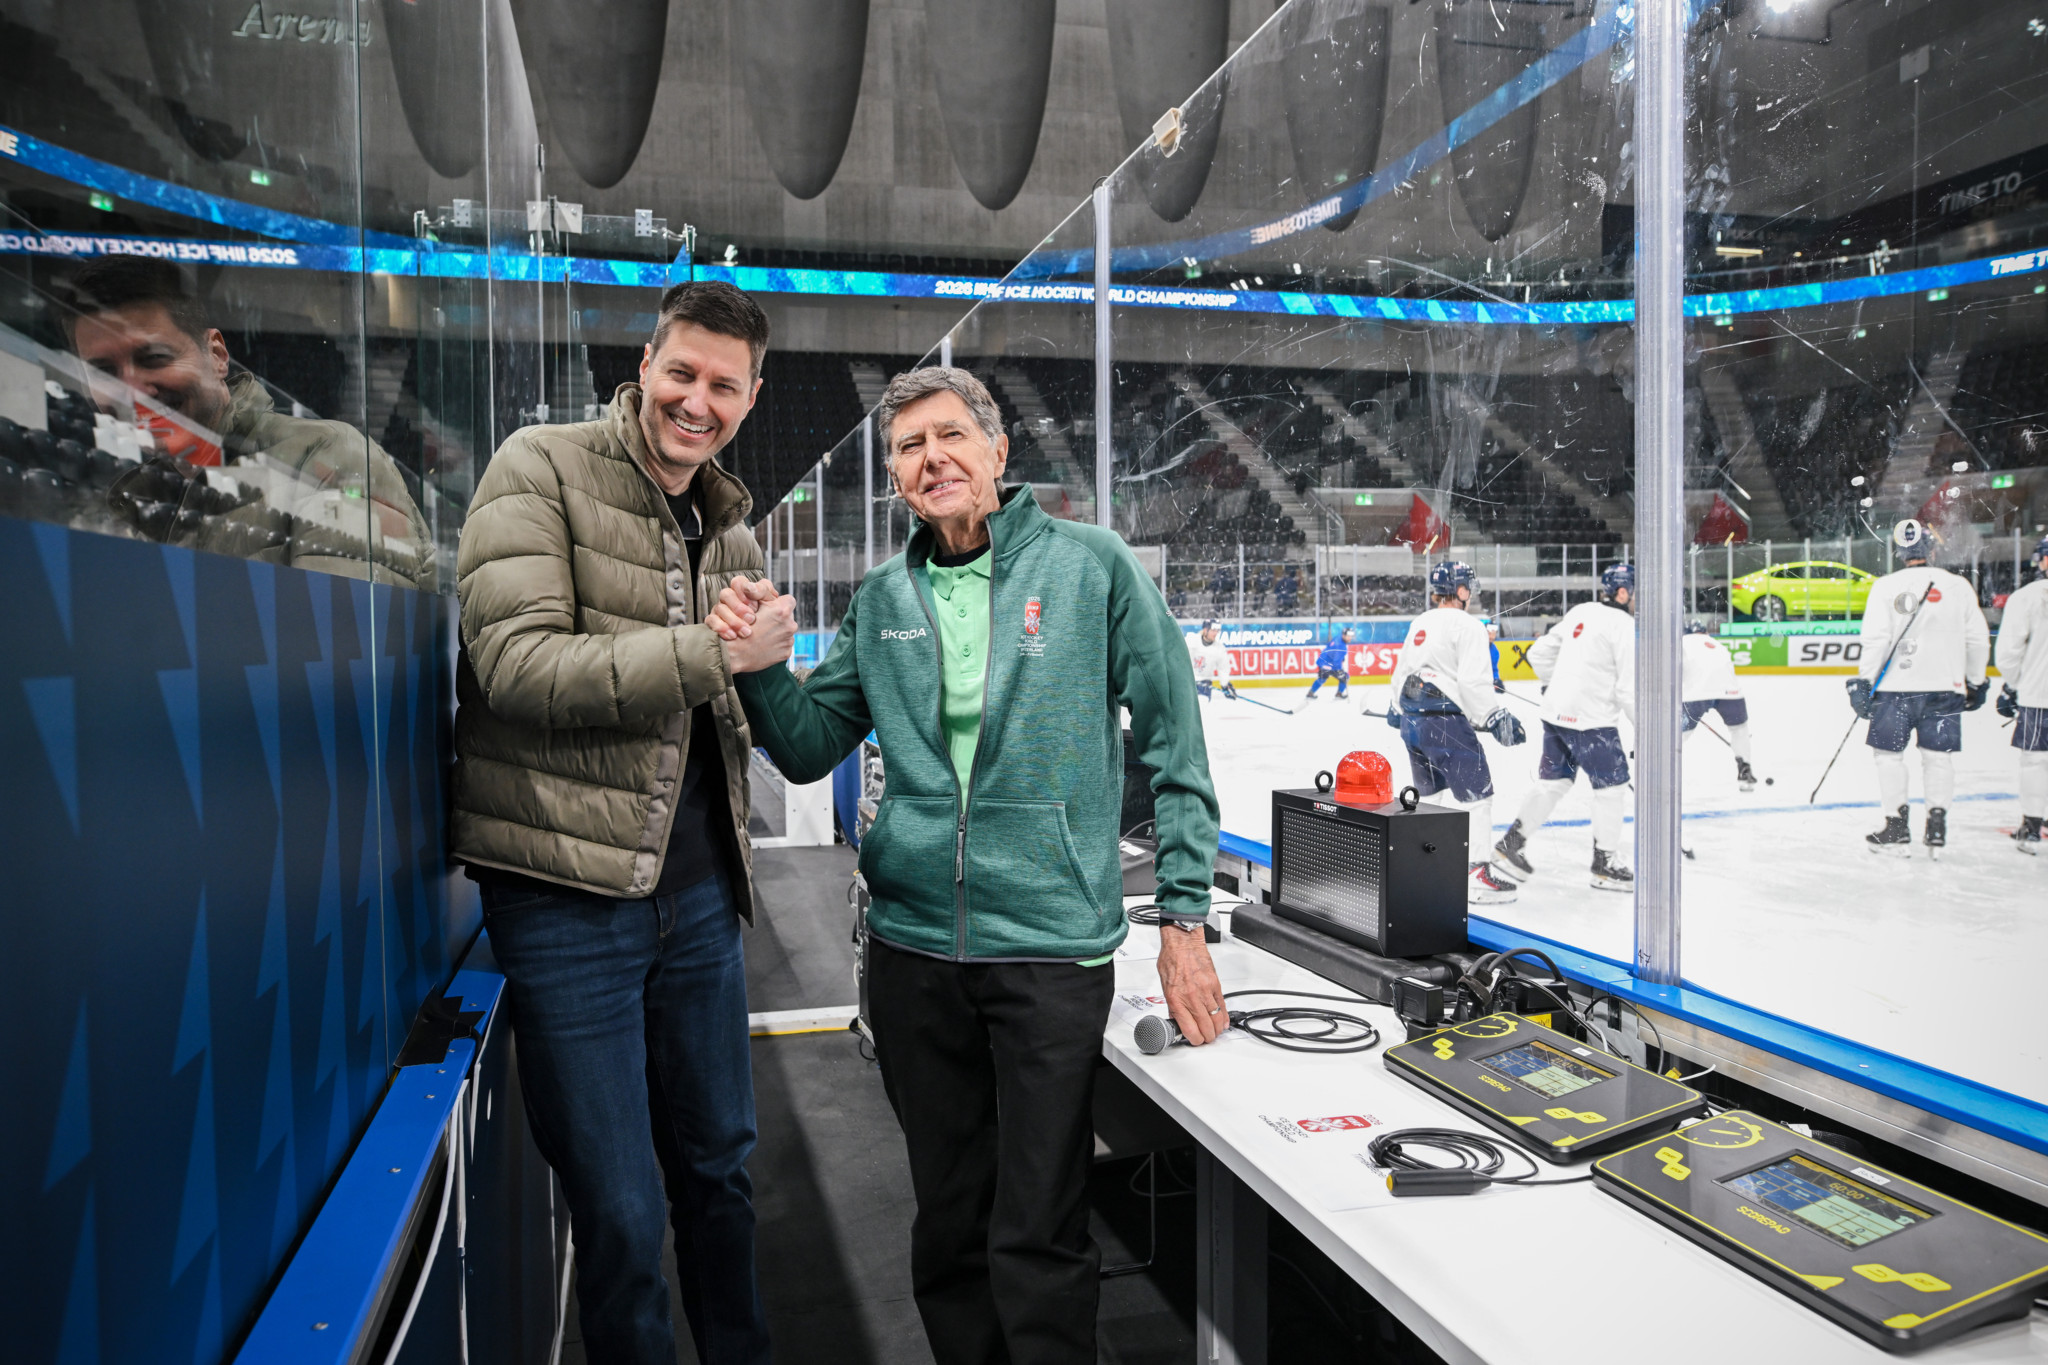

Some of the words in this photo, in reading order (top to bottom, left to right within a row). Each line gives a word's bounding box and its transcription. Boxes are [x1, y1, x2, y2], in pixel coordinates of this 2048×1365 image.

[1992, 172, 2022, 197] TO
[1990, 253, 2036, 275] TIME
[2036, 250, 2048, 267] T
[1004, 286, 1031, 299] ICE
[1030, 285, 1081, 300] HOCKEY
[1136, 289, 1238, 307] CHAMPIONSHIP
[1219, 630, 1313, 646] AMPIONSHIP
[1229, 652, 1320, 672] AUHAU
[1801, 643, 1863, 662] SPO
[1829, 1182, 1865, 1200] 60:00
[1736, 1205, 1792, 1234] SCOREPAD
